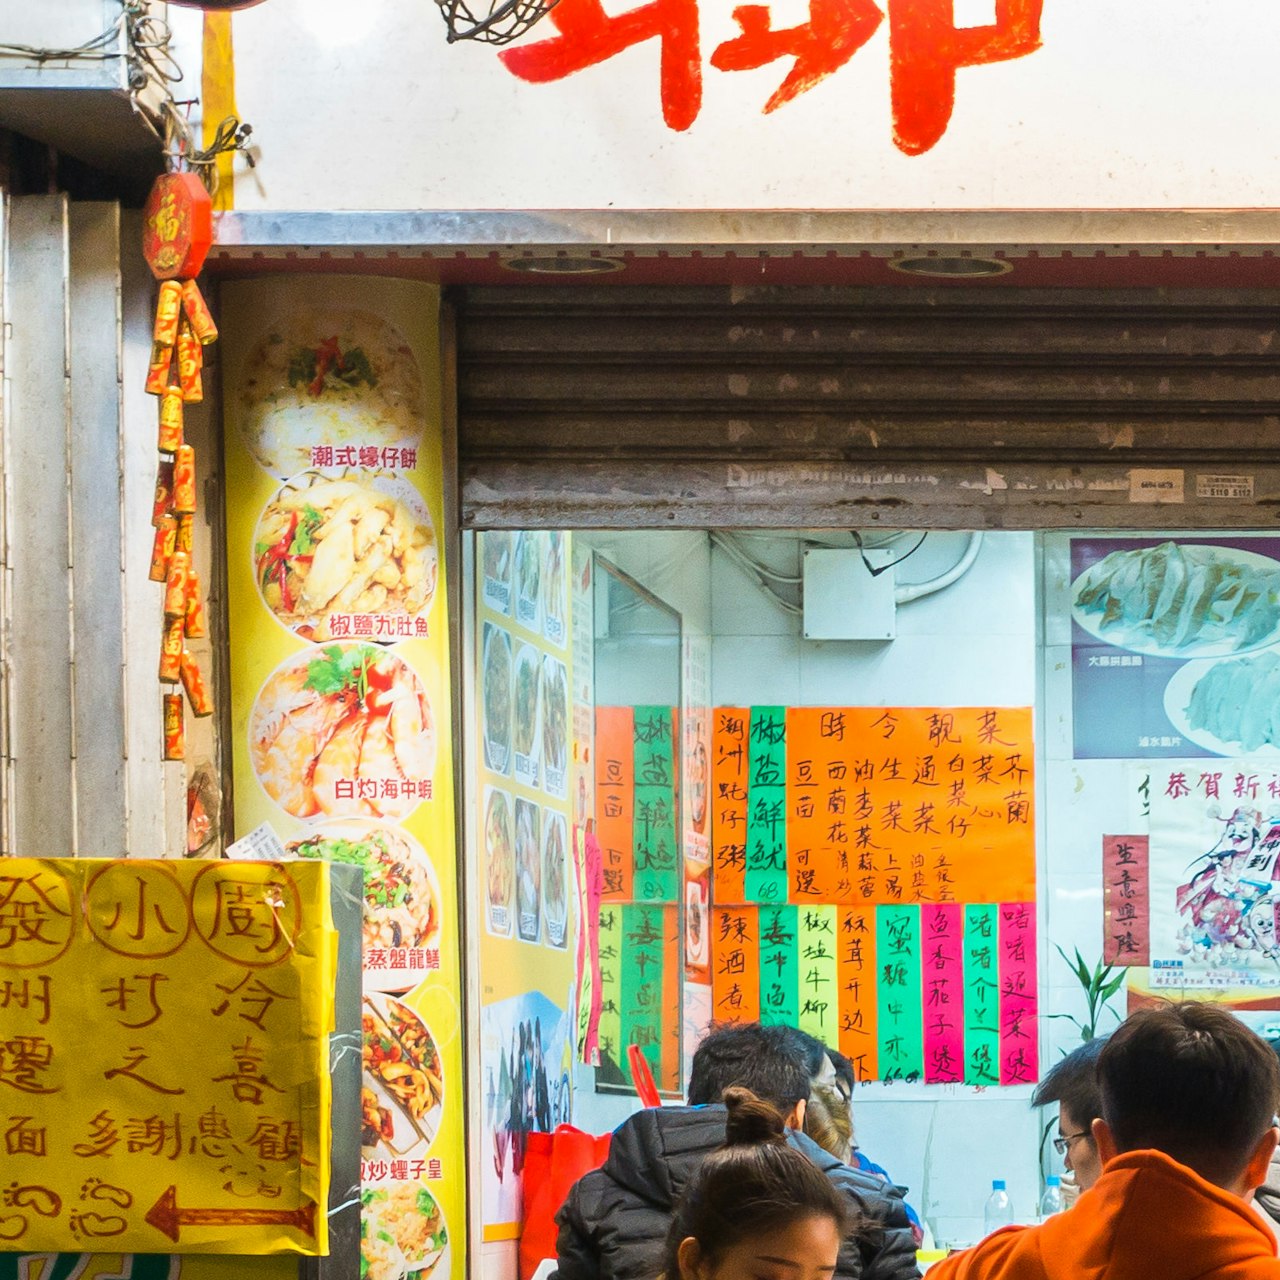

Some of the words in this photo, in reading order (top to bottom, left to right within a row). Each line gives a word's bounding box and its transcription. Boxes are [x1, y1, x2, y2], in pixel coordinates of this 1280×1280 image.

[310, 445, 418, 470] 潮式蠔仔餅
[328, 614, 430, 638] 椒鹽九肚魚
[821, 710, 1018, 748] 時令靚菜
[334, 777, 433, 801] 白灼海中蝦
[879, 757, 912, 834] 生菜
[757, 880, 779, 899] 68
[362, 947, 440, 971] 蒸盤龍鱔
[719, 912, 753, 1022] 辣酒煮
